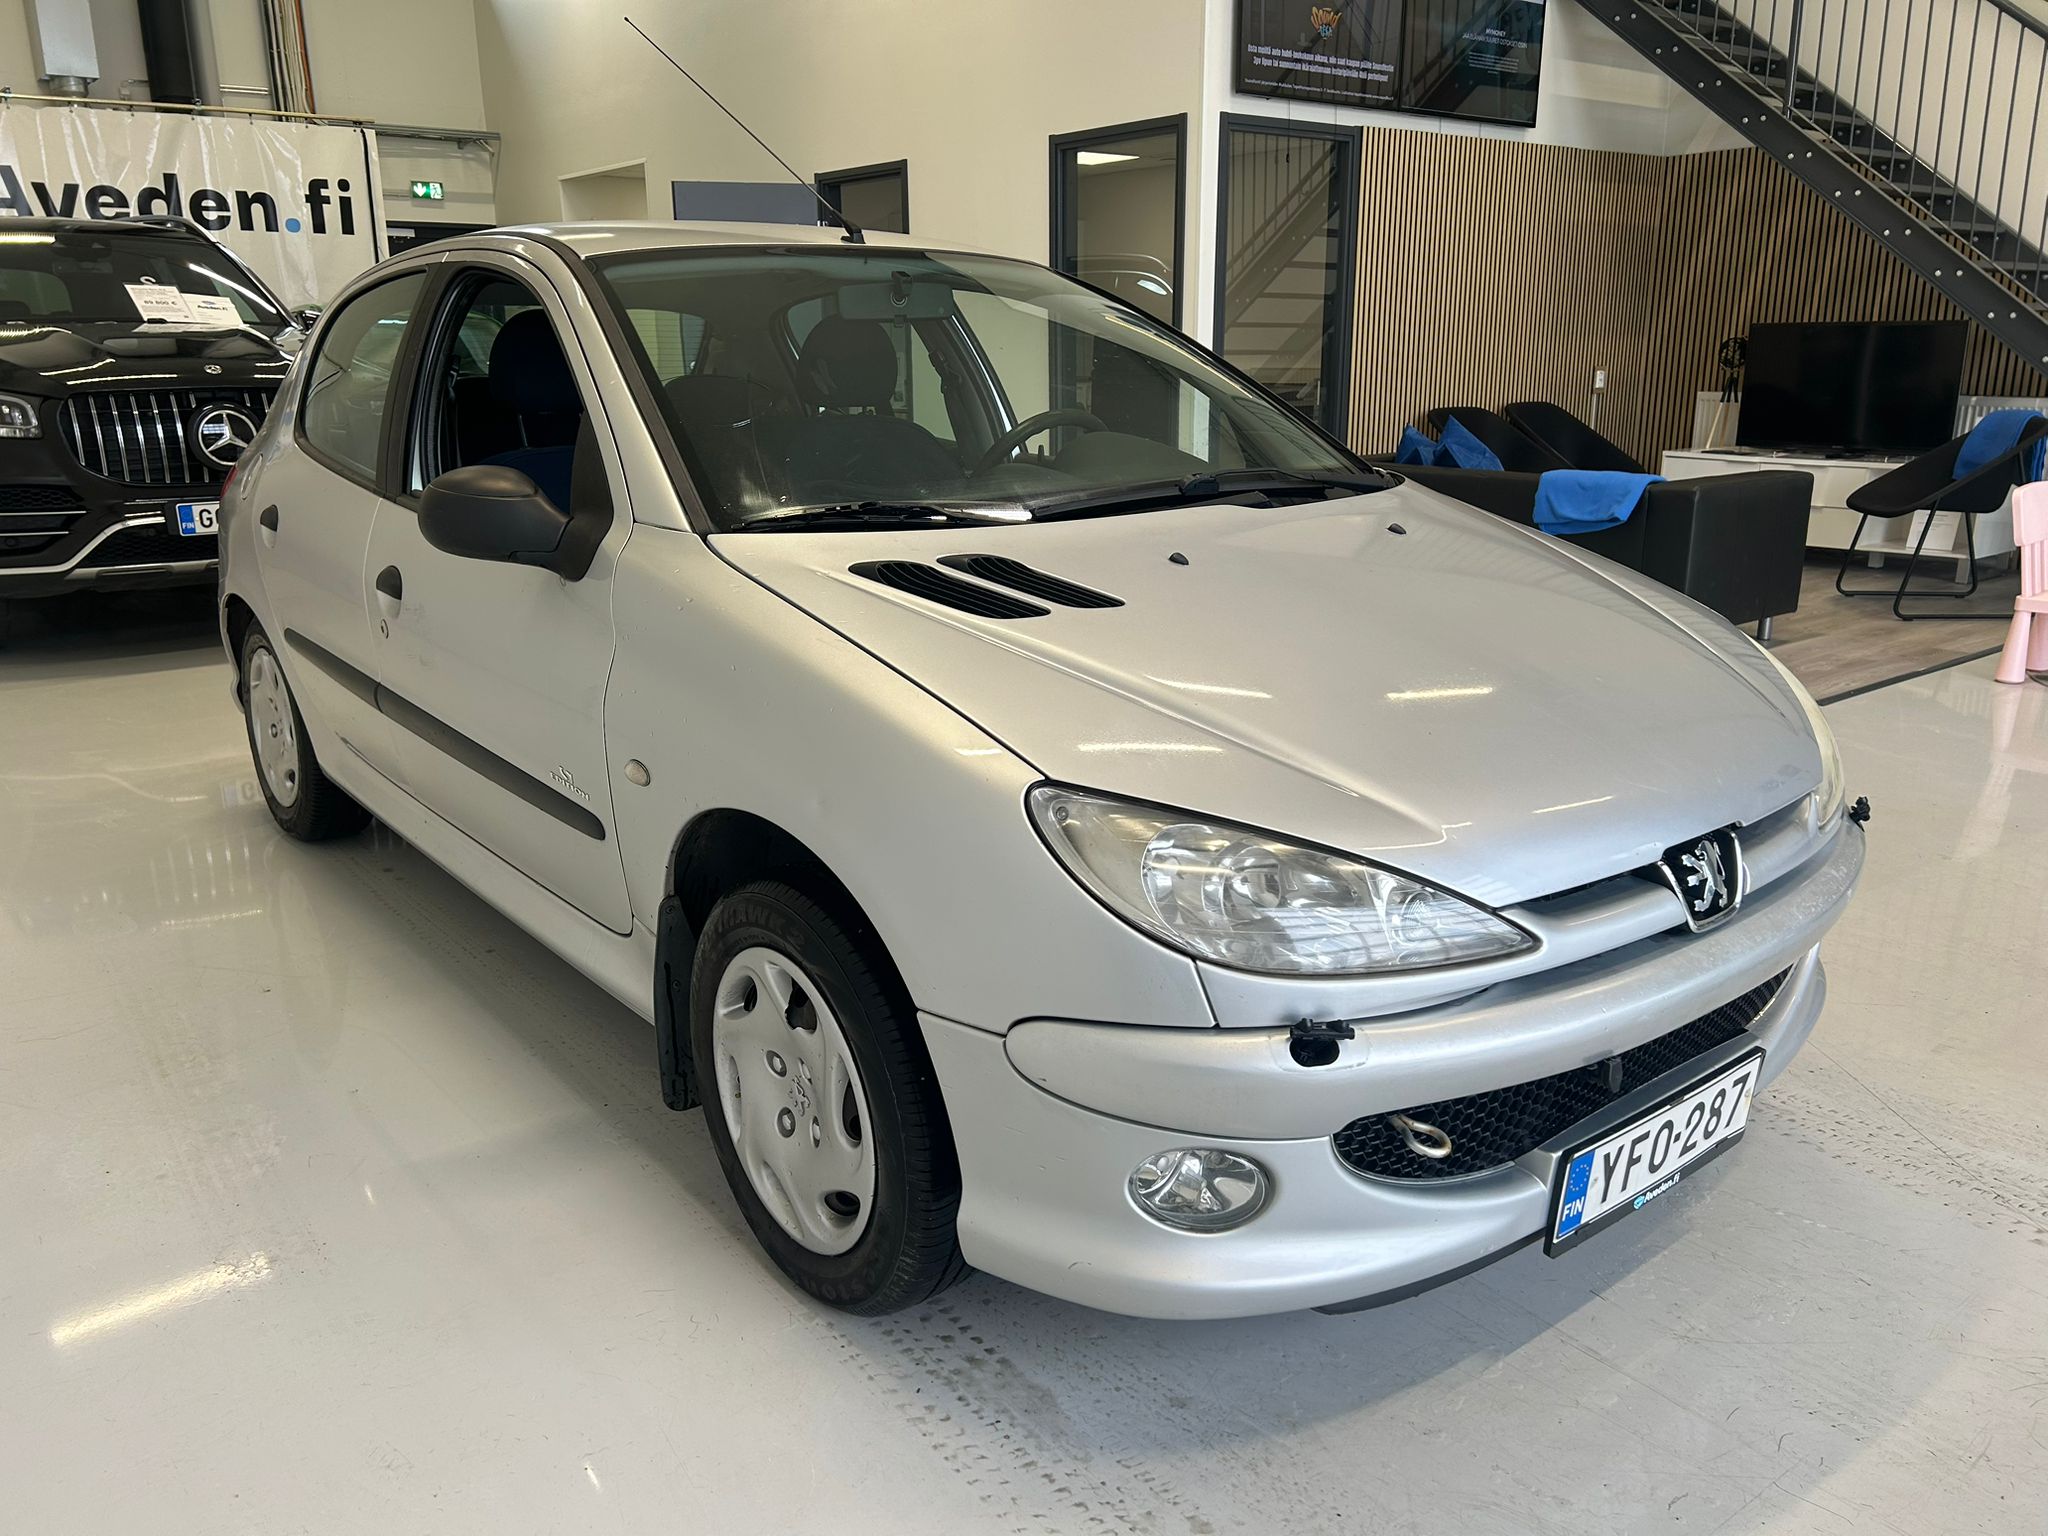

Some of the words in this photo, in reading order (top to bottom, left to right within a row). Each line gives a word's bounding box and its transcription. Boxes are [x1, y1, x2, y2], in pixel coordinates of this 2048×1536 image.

[199, 508, 219, 528] G
[1601, 1070, 1752, 1204] YFO-287
[1643, 1172, 1680, 1203] Aveden.fi
[1562, 1196, 1585, 1222] FIN
